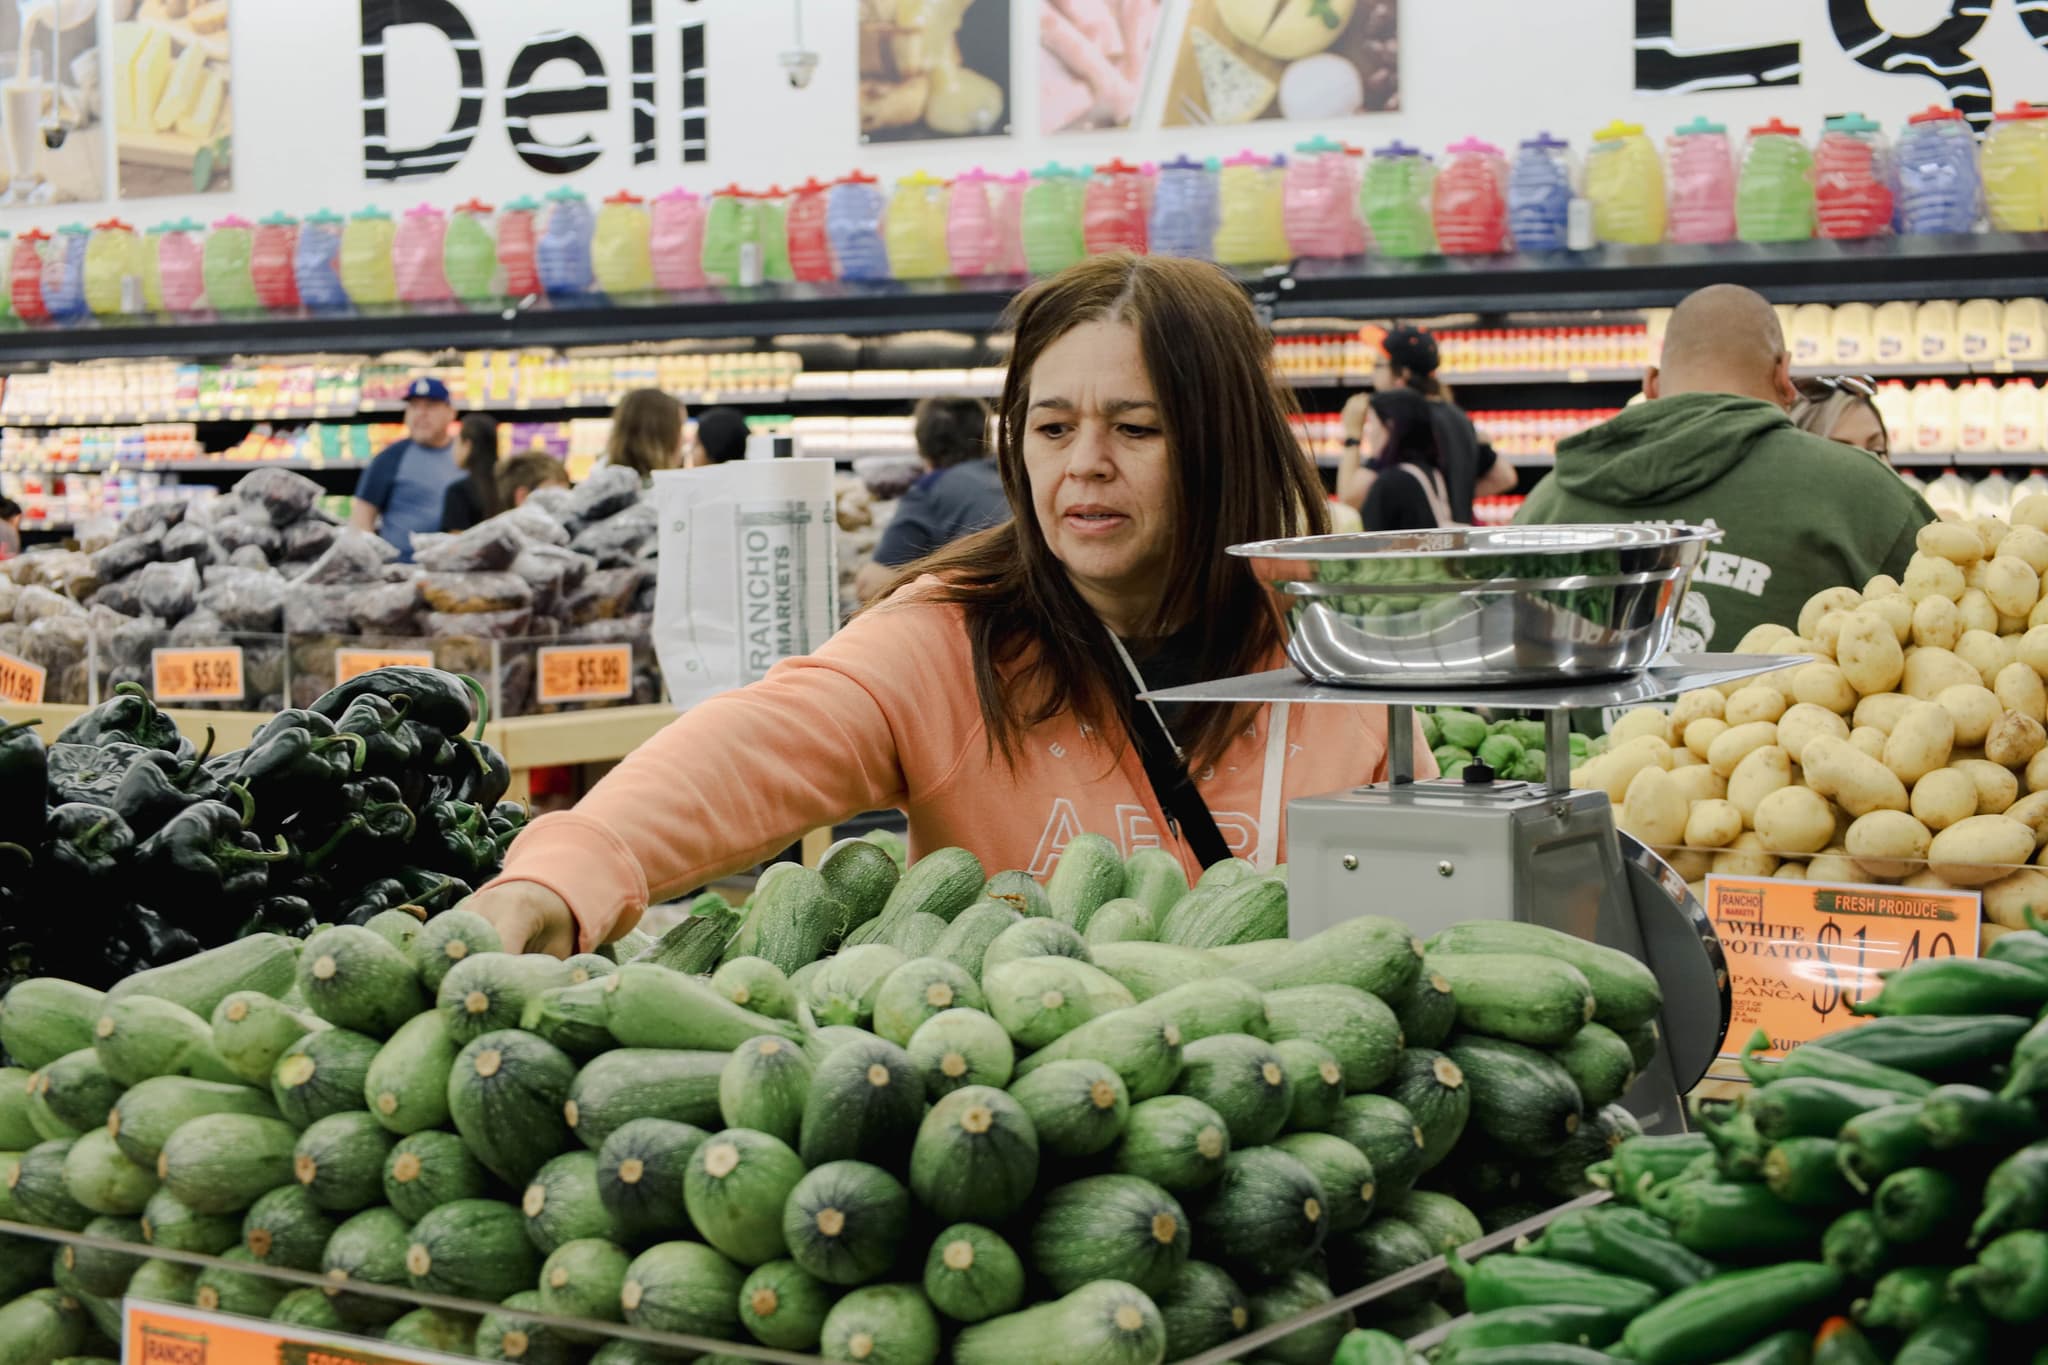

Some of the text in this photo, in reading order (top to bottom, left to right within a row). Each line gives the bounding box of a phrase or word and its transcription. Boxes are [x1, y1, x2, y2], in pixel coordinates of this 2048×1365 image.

[360, 0, 707, 182] Deli
[746, 530, 771, 671] RANCHO
[774, 545, 792, 654] MARKETS
[1722, 894, 1760, 907] RANCHO
[1835, 896, 1938, 918] FRESH PRODUCE
[1727, 921, 1805, 941] WHITE
[1732, 975, 1788, 989] PAPA
[149, 1339, 200, 1365] RANCHO
